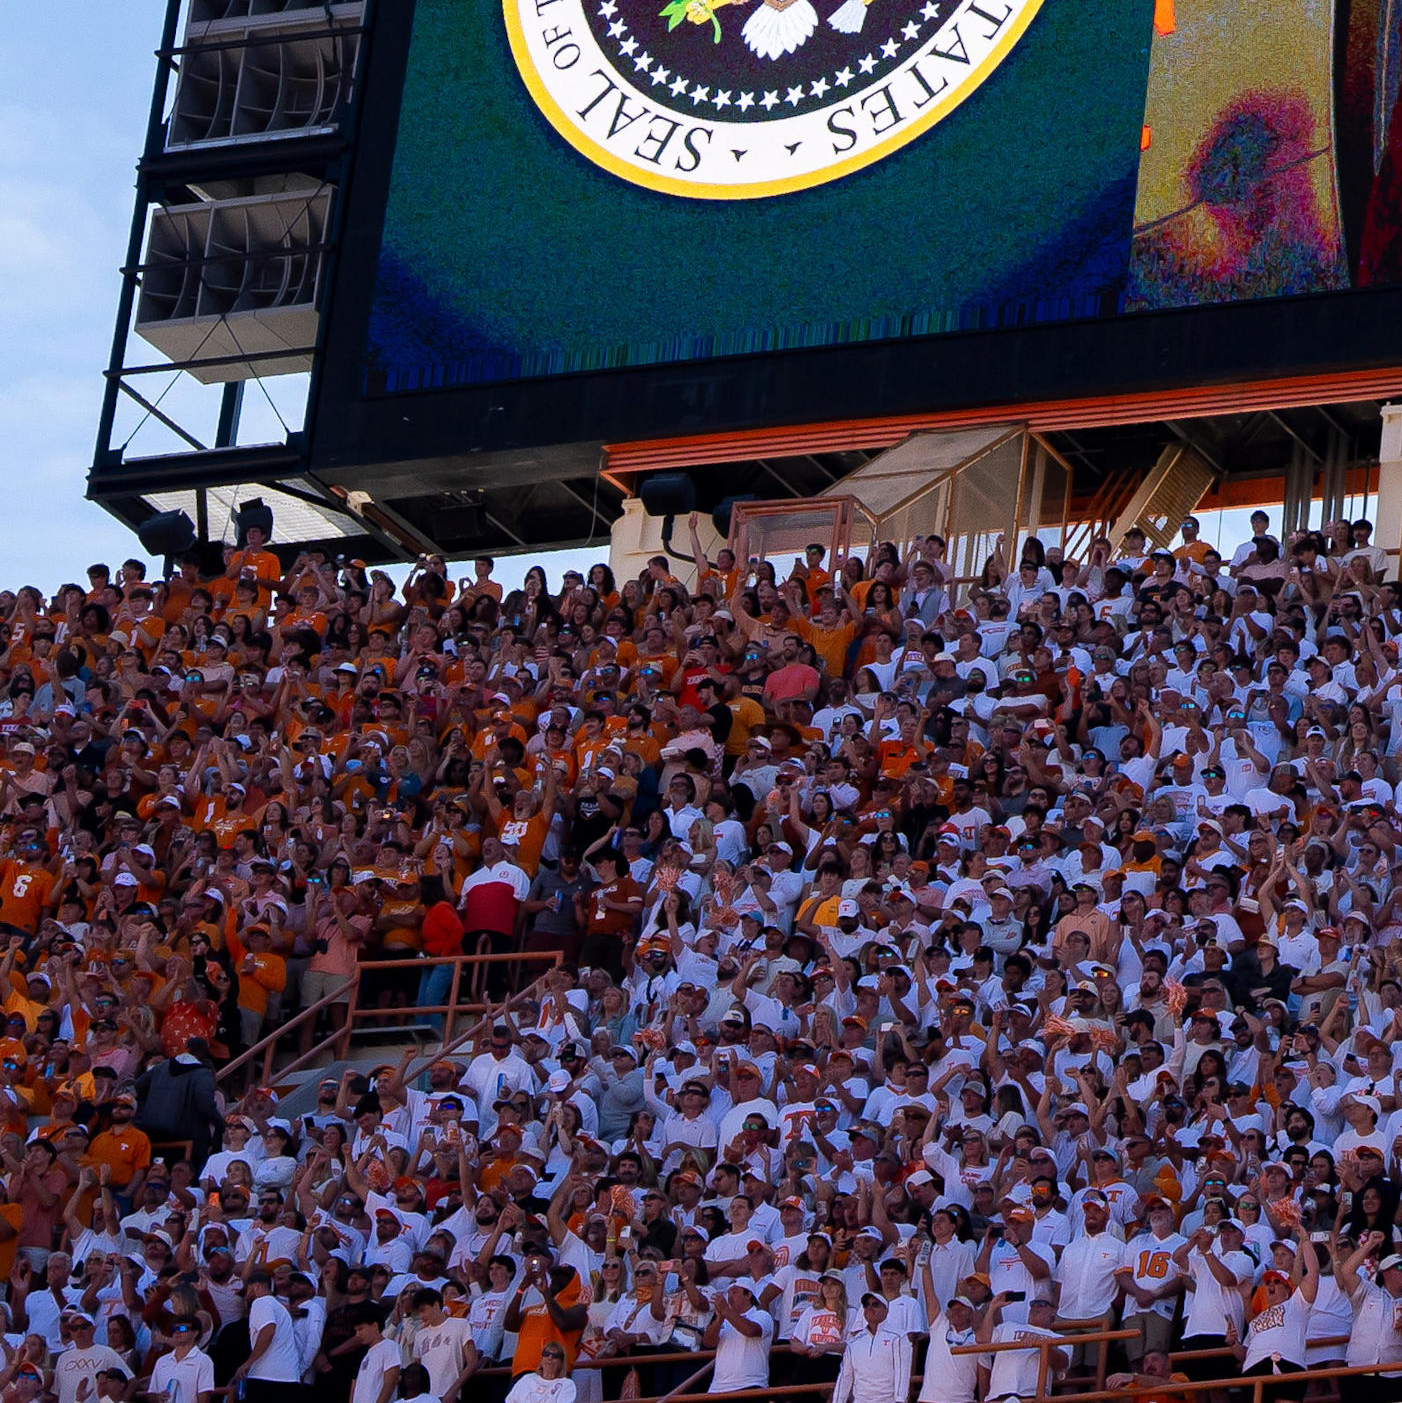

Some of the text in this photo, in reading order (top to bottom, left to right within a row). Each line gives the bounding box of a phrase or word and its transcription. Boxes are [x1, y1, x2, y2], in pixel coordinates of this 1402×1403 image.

[543, 27, 580, 69] OF
[576, 69, 713, 171] SEAL
[501, 821, 528, 838] 50
[14, 876, 32, 898] 6
[784, 1111, 815, 1139] T
[1107, 1190, 1123, 1202] T
[1137, 1251, 1170, 1278] 16
